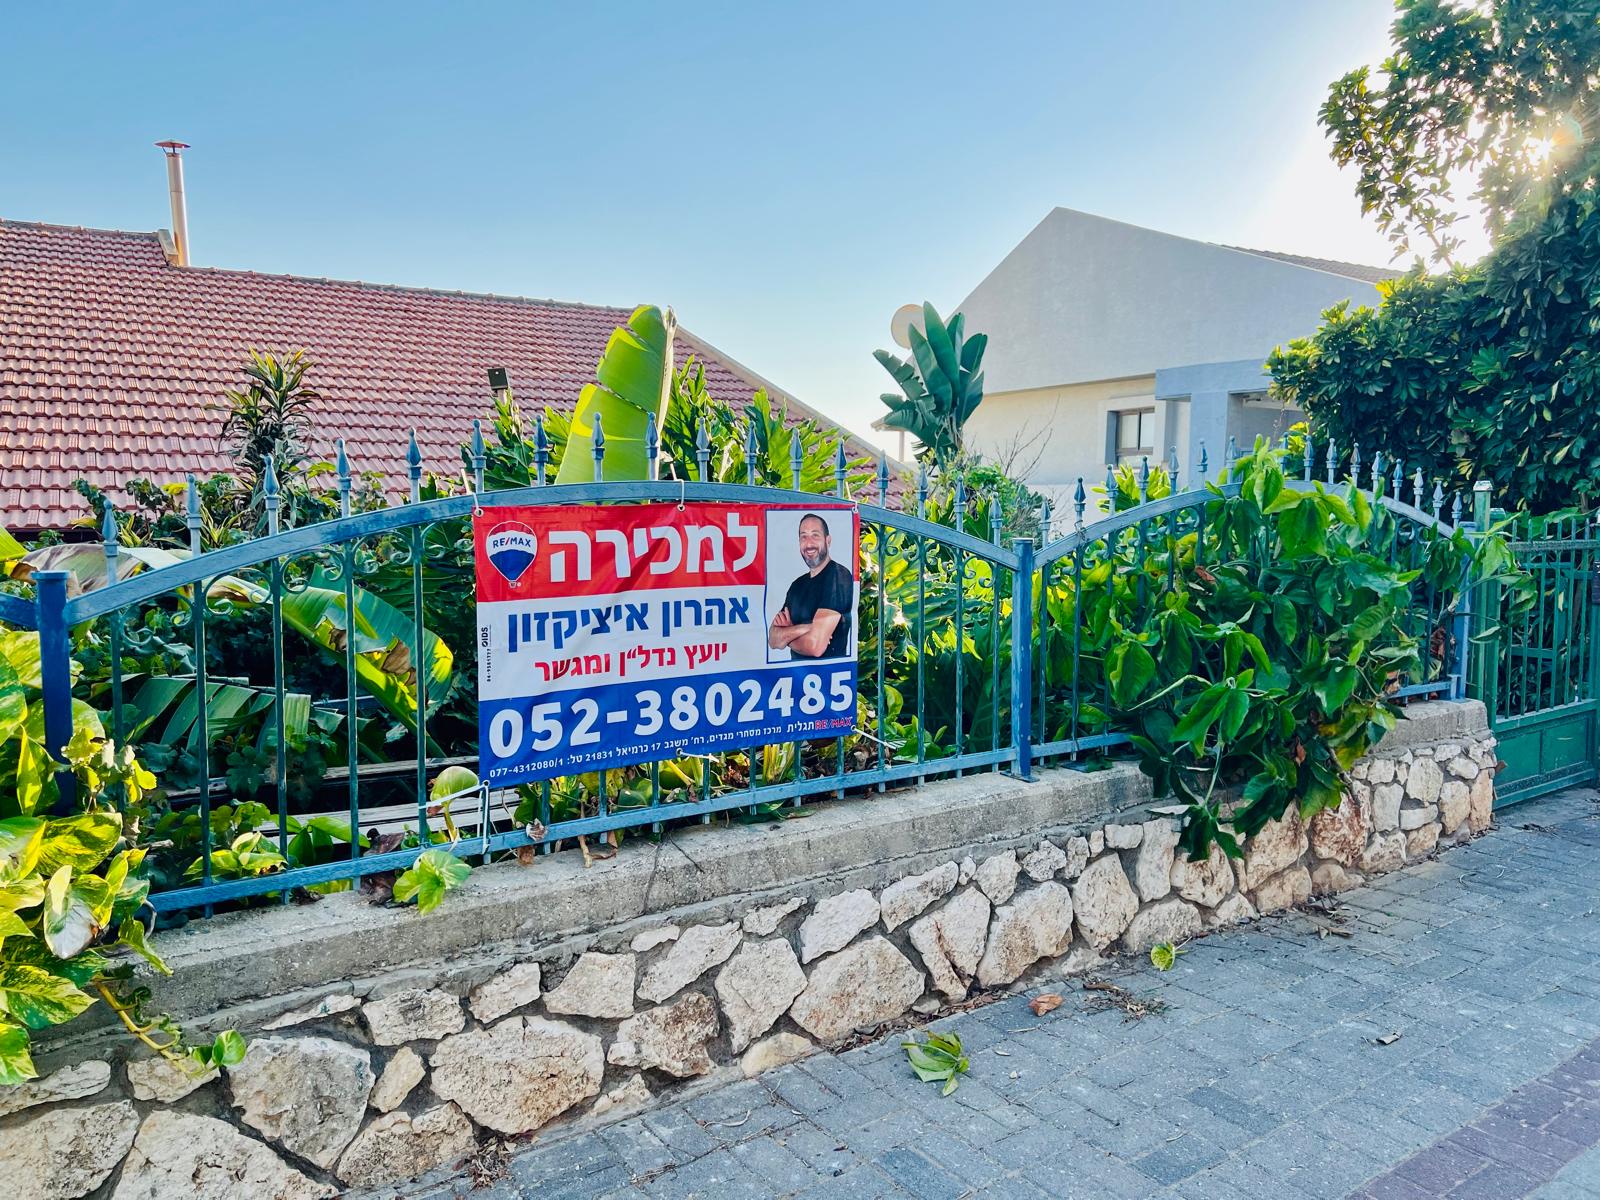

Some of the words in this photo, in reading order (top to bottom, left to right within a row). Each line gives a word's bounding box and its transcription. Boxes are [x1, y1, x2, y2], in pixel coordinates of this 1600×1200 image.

[492, 536, 532, 549] RE/MAX
[548, 511, 759, 583] למכירה
[661, 596, 751, 637] אהרון
[507, 602, 650, 654] איציקזון
[683, 642, 728, 670] יועץ
[534, 653, 611, 682] ומגשר
[488, 670, 854, 759] 052-3802485
[786, 719, 815, 733] תגלית
[814, 716, 853, 730] RE/MAX
[736, 728, 761, 739] מסחרי
[763, 726, 781, 736] מרכז
[615, 744, 649, 757] כרמיאל
[650, 742, 661, 751] 17
[664, 738, 689, 749] משגב
[585, 749, 614, 762] 21831
[489, 757, 563, 778] 077-4312080/1
